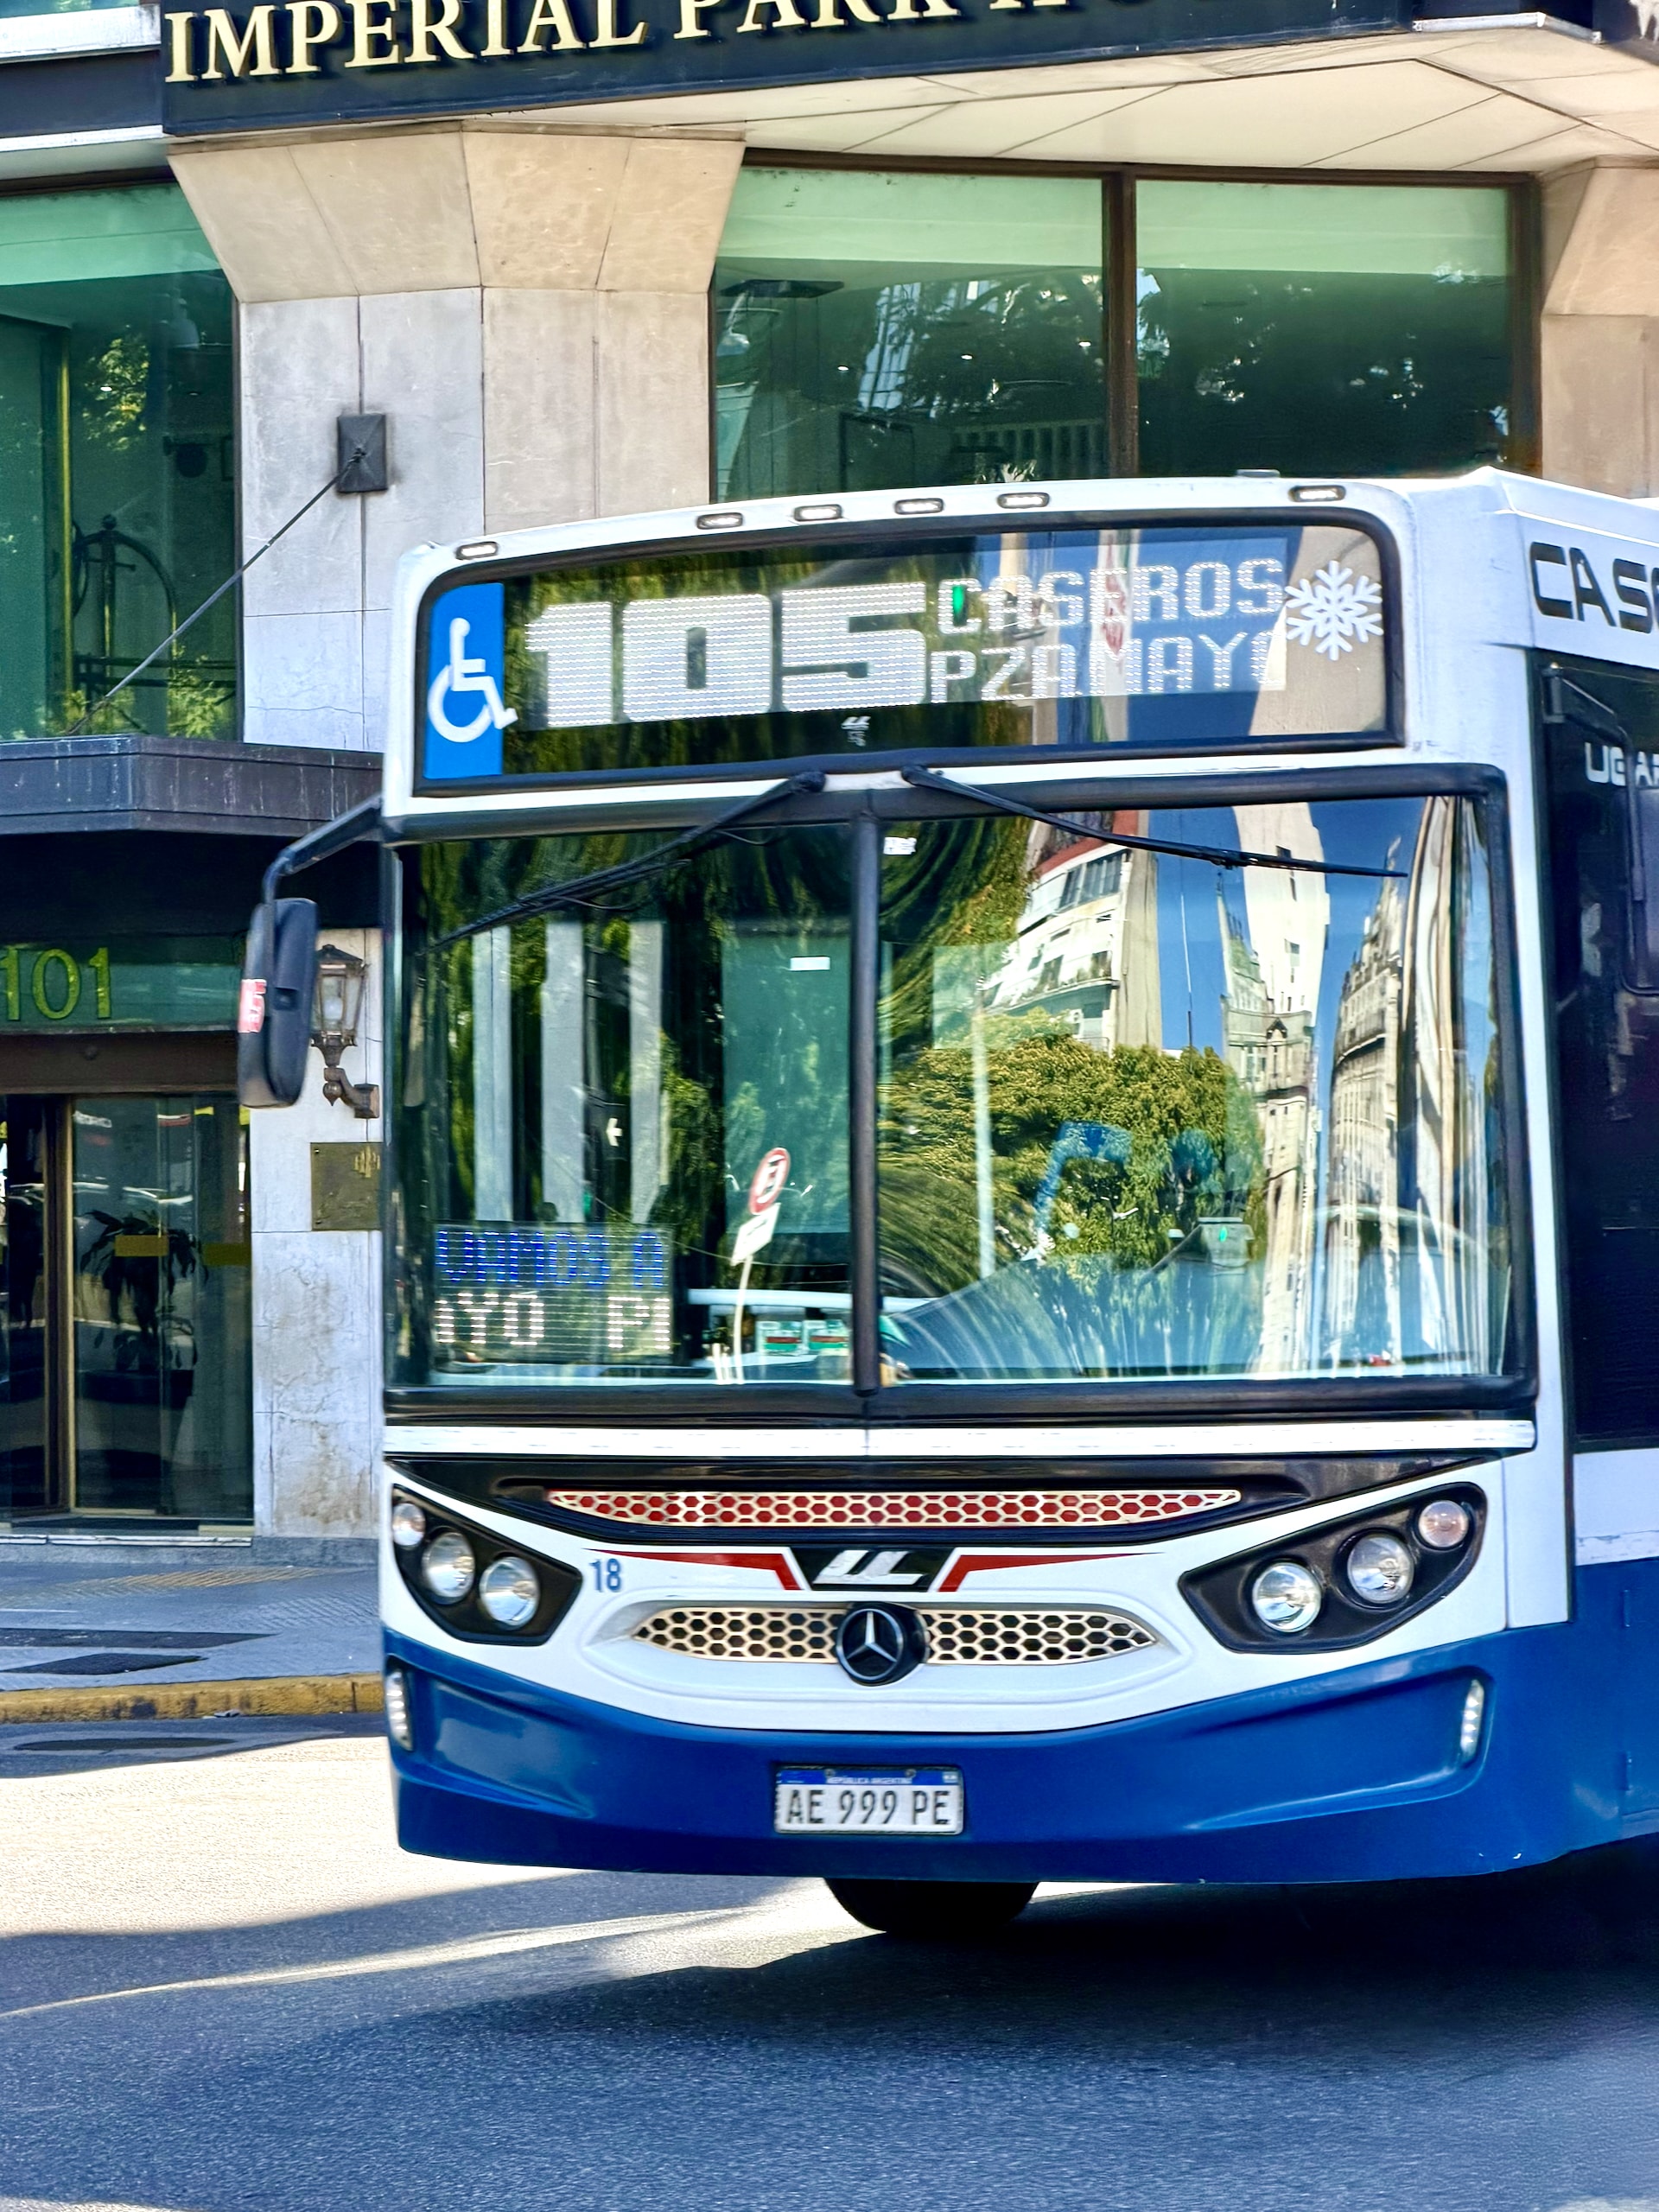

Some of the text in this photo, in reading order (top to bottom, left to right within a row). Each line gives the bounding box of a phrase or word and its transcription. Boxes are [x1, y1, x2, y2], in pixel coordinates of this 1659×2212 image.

[165, 0, 646, 82] IMPERIAL
[938, 557, 1285, 634] CASEROS
[1529, 541, 1659, 634] CAS
[525, 581, 927, 728] 105
[0, 946, 111, 1020] 101
[436, 1230, 664, 1287] VAMOS A
[588, 1558, 621, 1592] 18
[787, 1789, 950, 1825] AE 999 PE
